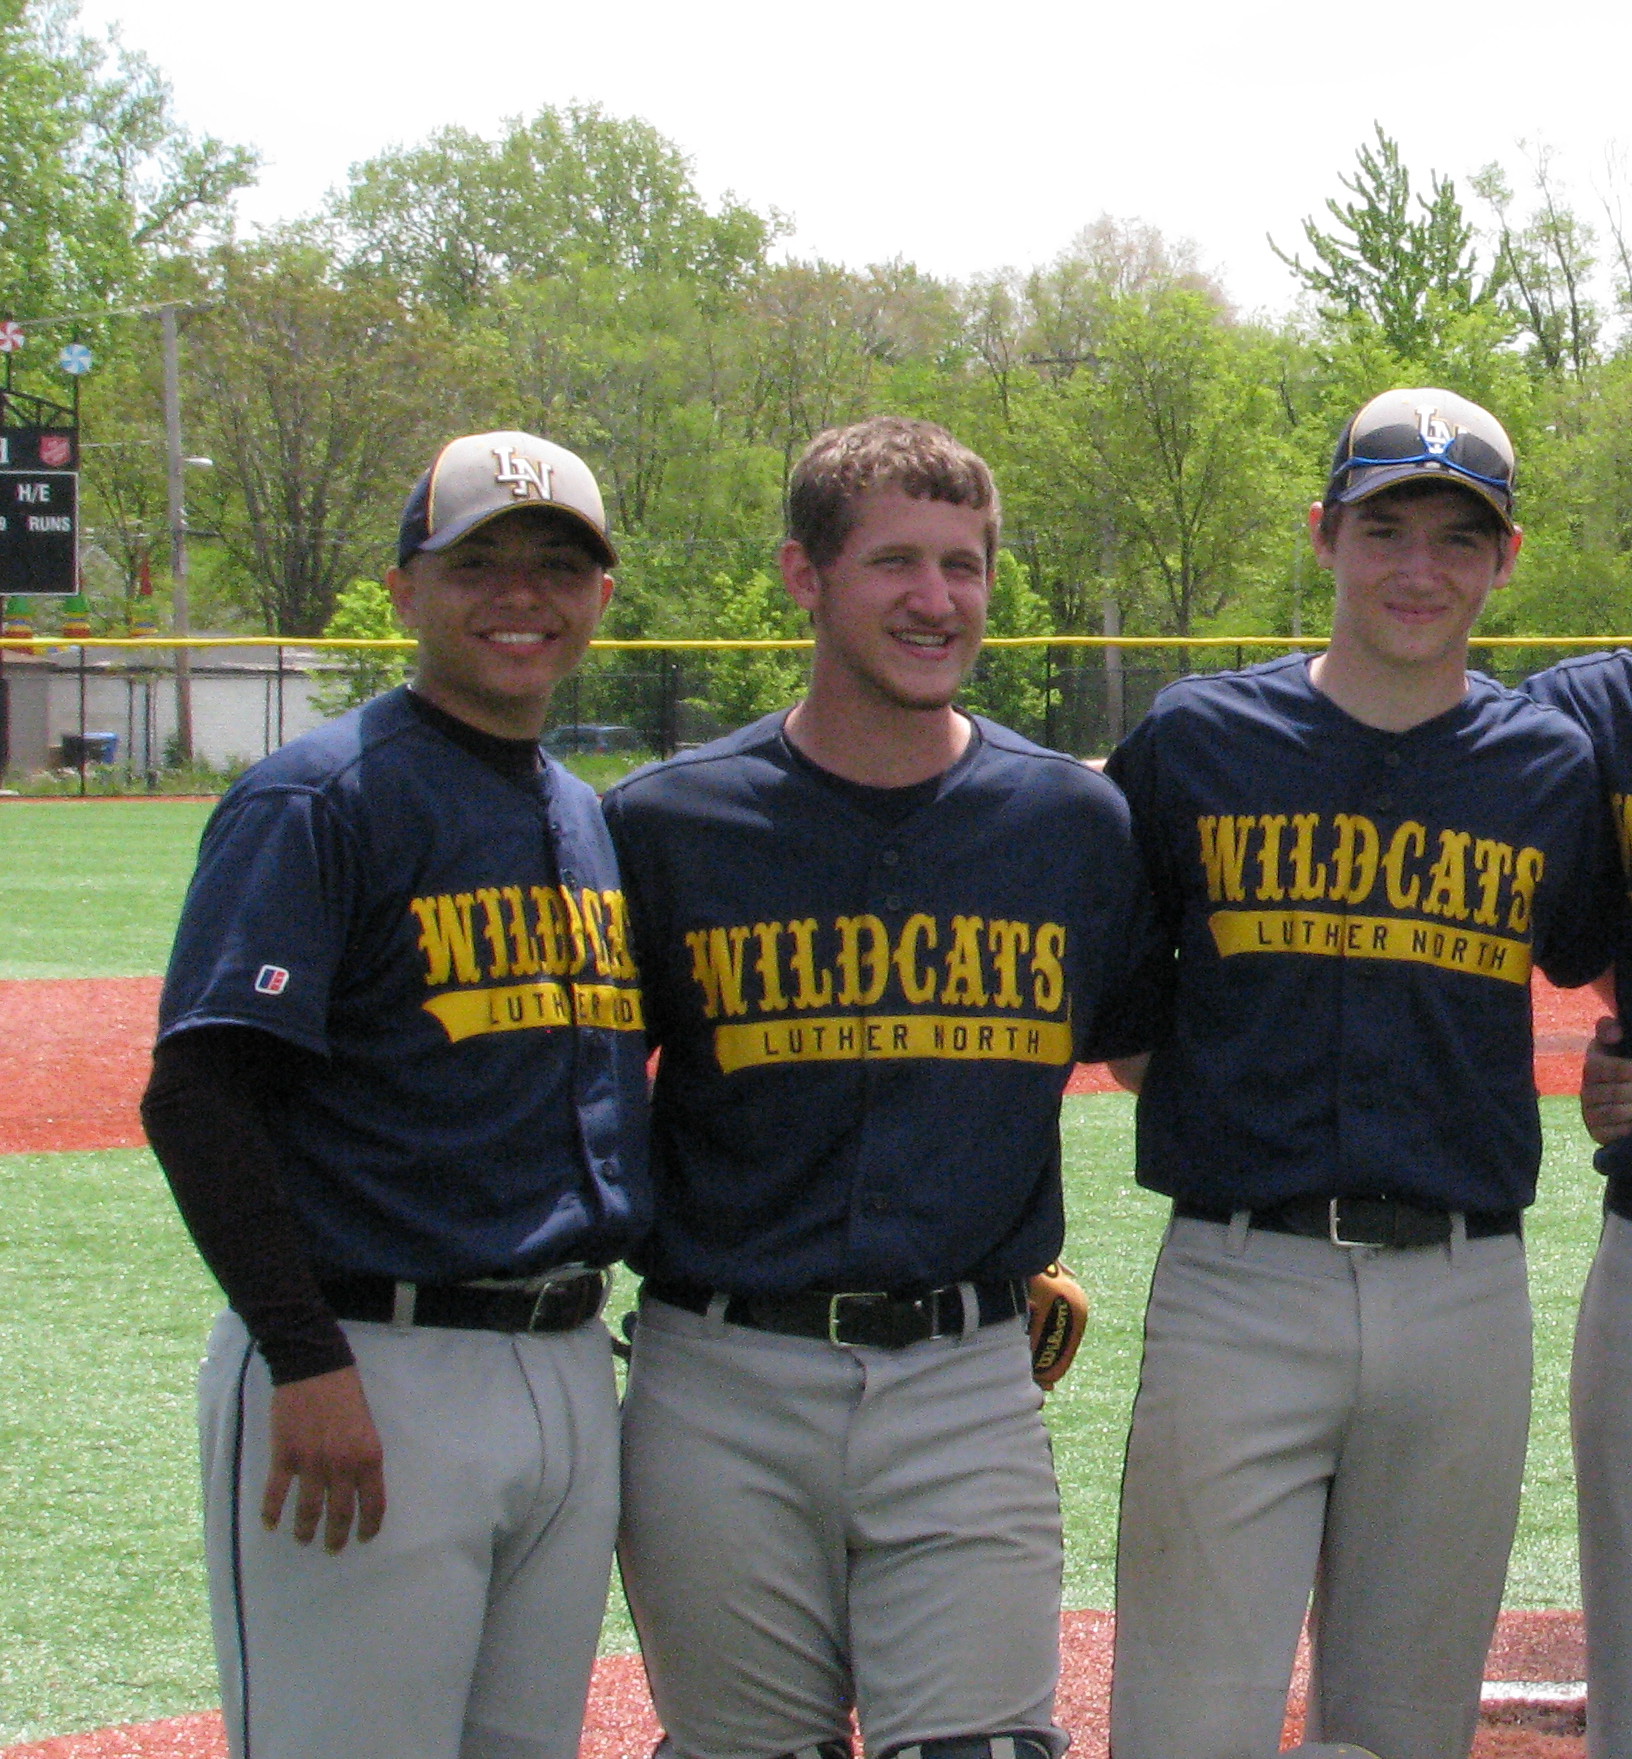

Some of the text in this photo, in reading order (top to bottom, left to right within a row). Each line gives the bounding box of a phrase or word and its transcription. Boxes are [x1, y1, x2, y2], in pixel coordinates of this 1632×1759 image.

[17, 482, 51, 502] H/E
[492, 446, 554, 501] LN
[28, 516, 71, 532] RUNS
[1196, 812, 1545, 934] WILDCATS
[684, 912, 1067, 1019] WILDCATS
[1257, 919, 1508, 970] LUTHER NORTH
[763, 1023, 1041, 1057] LUTHER NORTH
